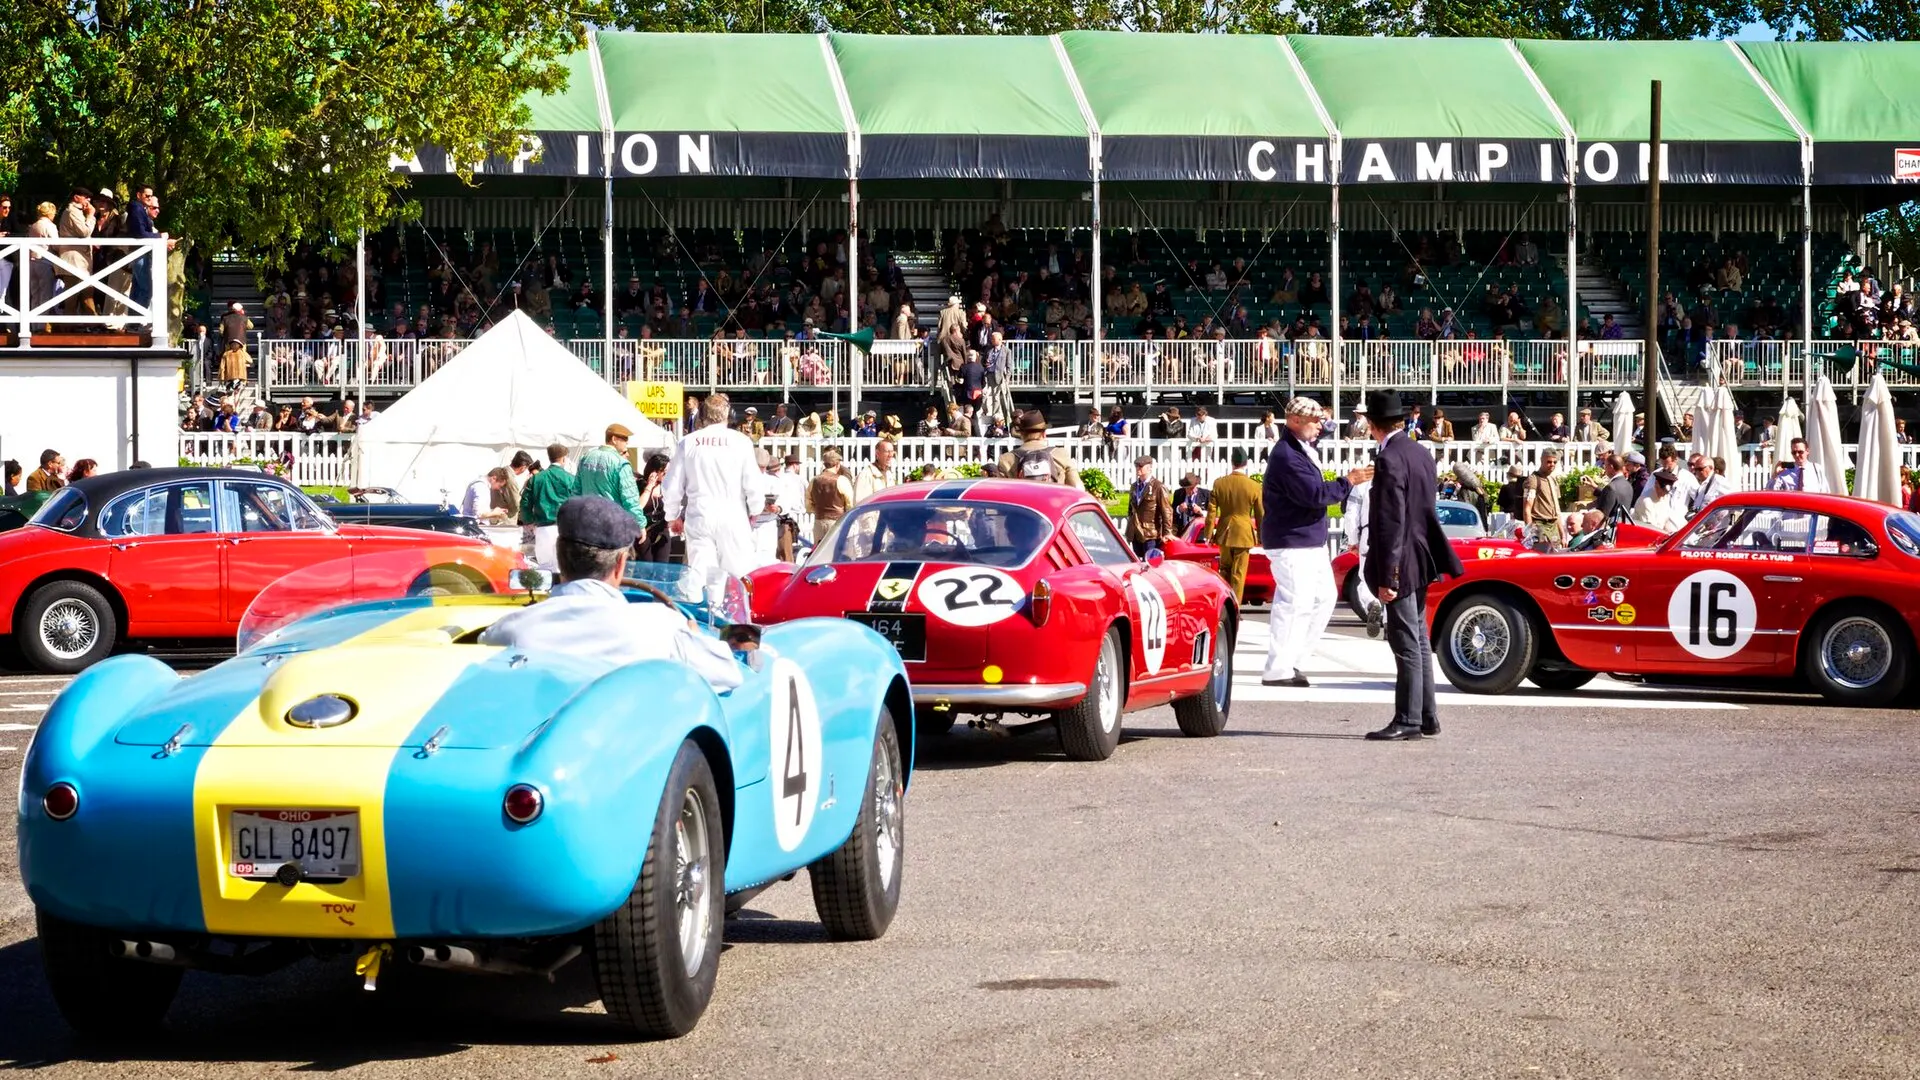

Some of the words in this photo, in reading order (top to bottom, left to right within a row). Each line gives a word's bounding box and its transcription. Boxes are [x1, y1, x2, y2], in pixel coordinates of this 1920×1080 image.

[1247, 140, 1669, 182] CHAMPION
[646, 385, 666, 398] LAPS
[695, 436, 728, 447] SHELL
[1680, 551, 1714, 559] PILOTO:
[1715, 552, 1750, 560] ROBERT
[1769, 554, 1794, 562] YUNG
[934, 573, 1015, 611] 22
[1614, 592, 1621, 602] E
[1140, 591, 1162, 650] 22
[1689, 582, 1737, 646] 16
[871, 619, 902, 635] 164
[783, 675, 807, 826] 4
[279, 811, 311, 821] OHIO
[239, 827, 282, 860] GLL
[292, 827, 350, 860] 8497
[237, 864, 253, 874] 09
[321, 904, 356, 914] TOW
